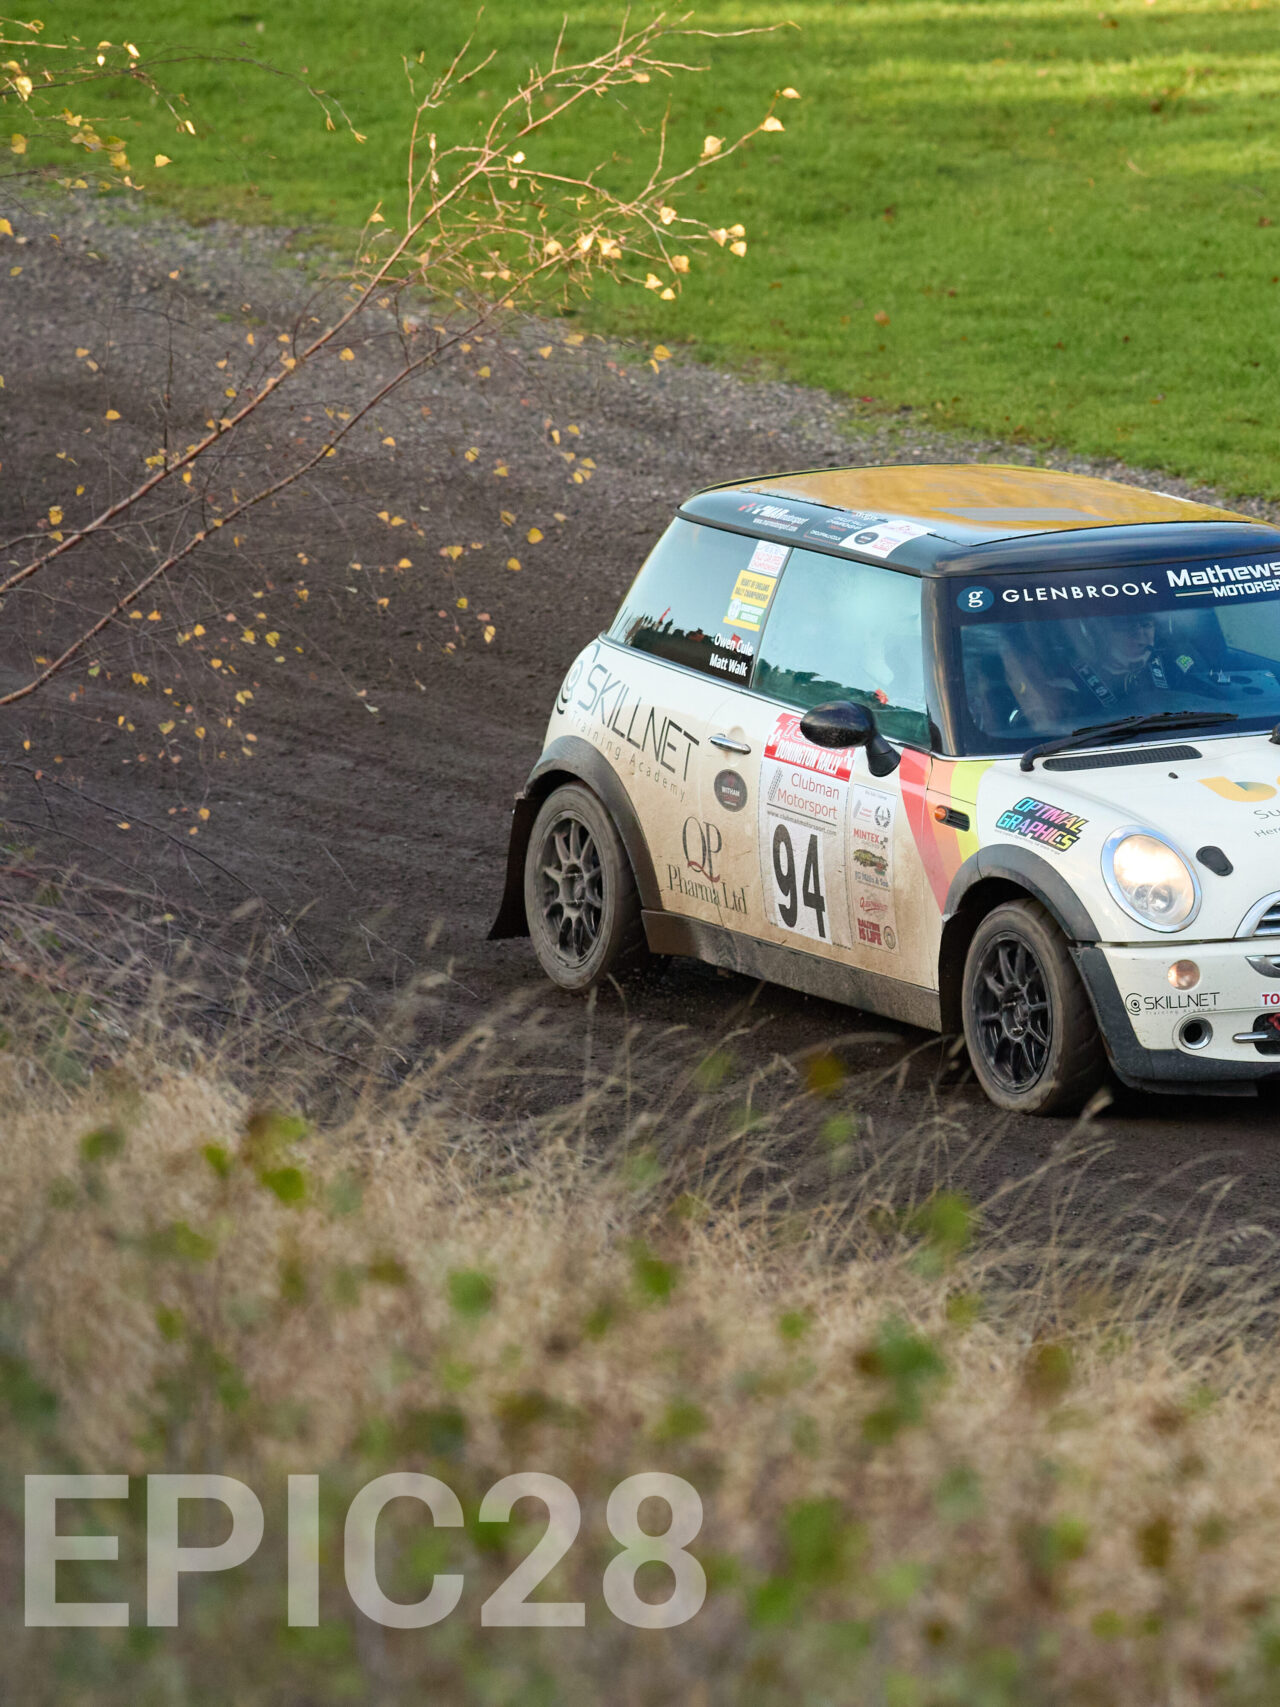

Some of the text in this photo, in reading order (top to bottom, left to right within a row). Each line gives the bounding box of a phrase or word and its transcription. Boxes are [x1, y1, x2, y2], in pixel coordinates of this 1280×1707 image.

[1002, 581, 1157, 602] GLENBROOK
[714, 632, 738, 650] Owen
[709, 653, 748, 676] Matt Walk
[577, 663, 700, 782] SKILLNET
[775, 740, 843, 774] DONINGTON RALLY
[630, 756, 687, 801] Academy
[791, 772, 840, 800] Clubman
[777, 788, 838, 820] Motorsport
[1014, 797, 1086, 834] OPTIMAL
[853, 828, 880, 843] MINTEX
[997, 812, 1077, 850] GRAPHICS
[666, 864, 749, 914] Pharma Ltd
[772, 824, 826, 938] 94
[1143, 992, 1221, 1010] SKILLNET
